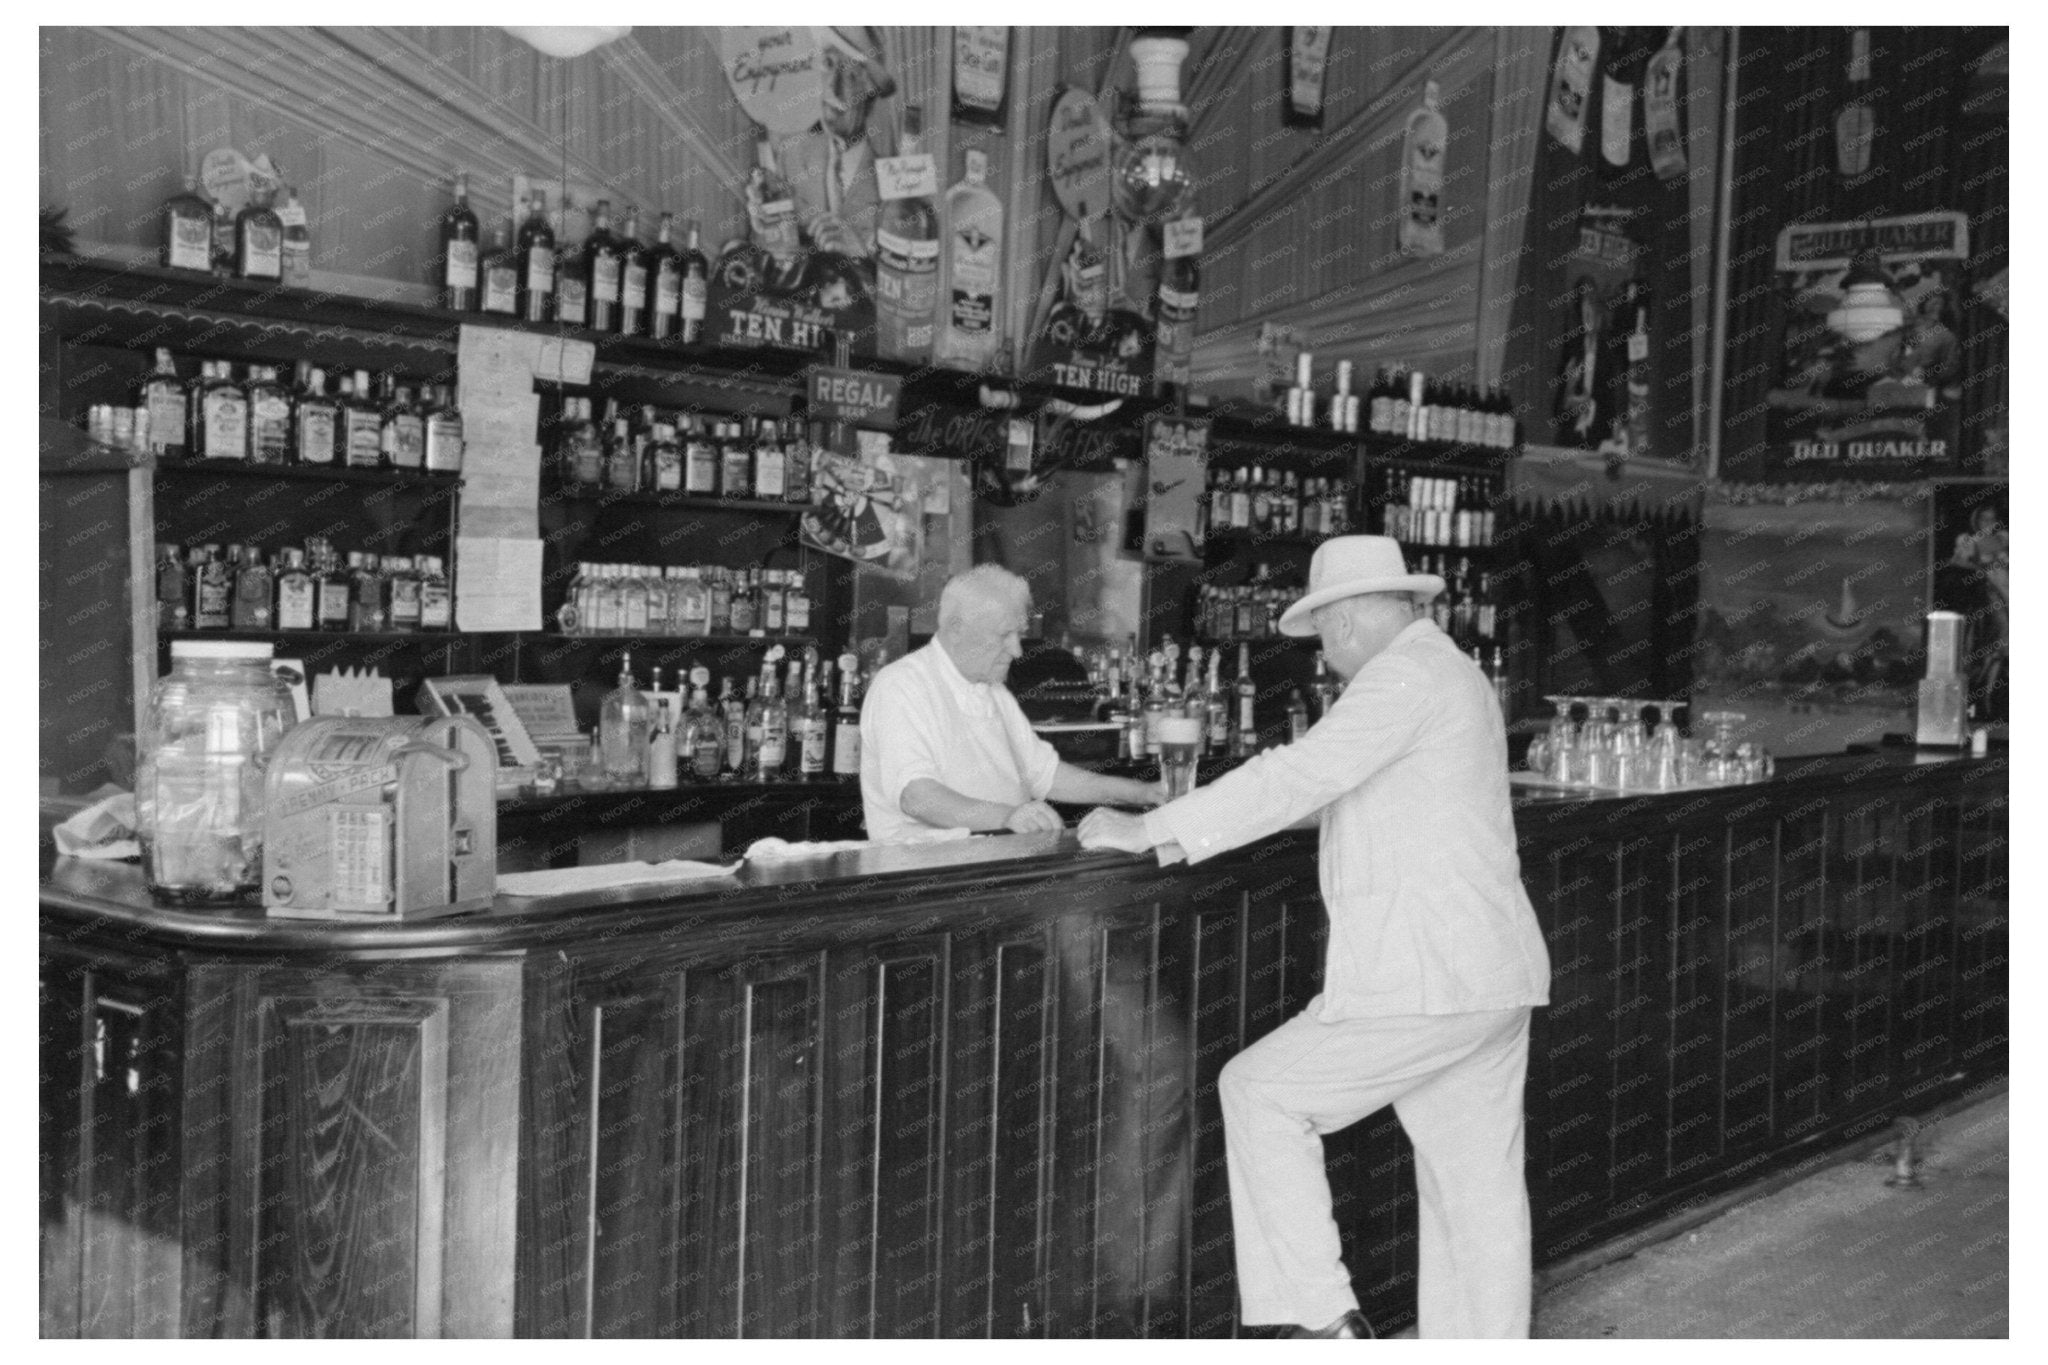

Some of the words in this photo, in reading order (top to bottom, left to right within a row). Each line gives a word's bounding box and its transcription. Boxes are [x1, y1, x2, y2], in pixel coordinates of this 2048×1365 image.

[729, 309, 783, 342] TEN
[817, 375, 893, 408] REGAL
[1053, 363, 1093, 389] TEN
[1096, 369, 1142, 396] HIGH
[1848, 438, 1948, 459] QUAKER
